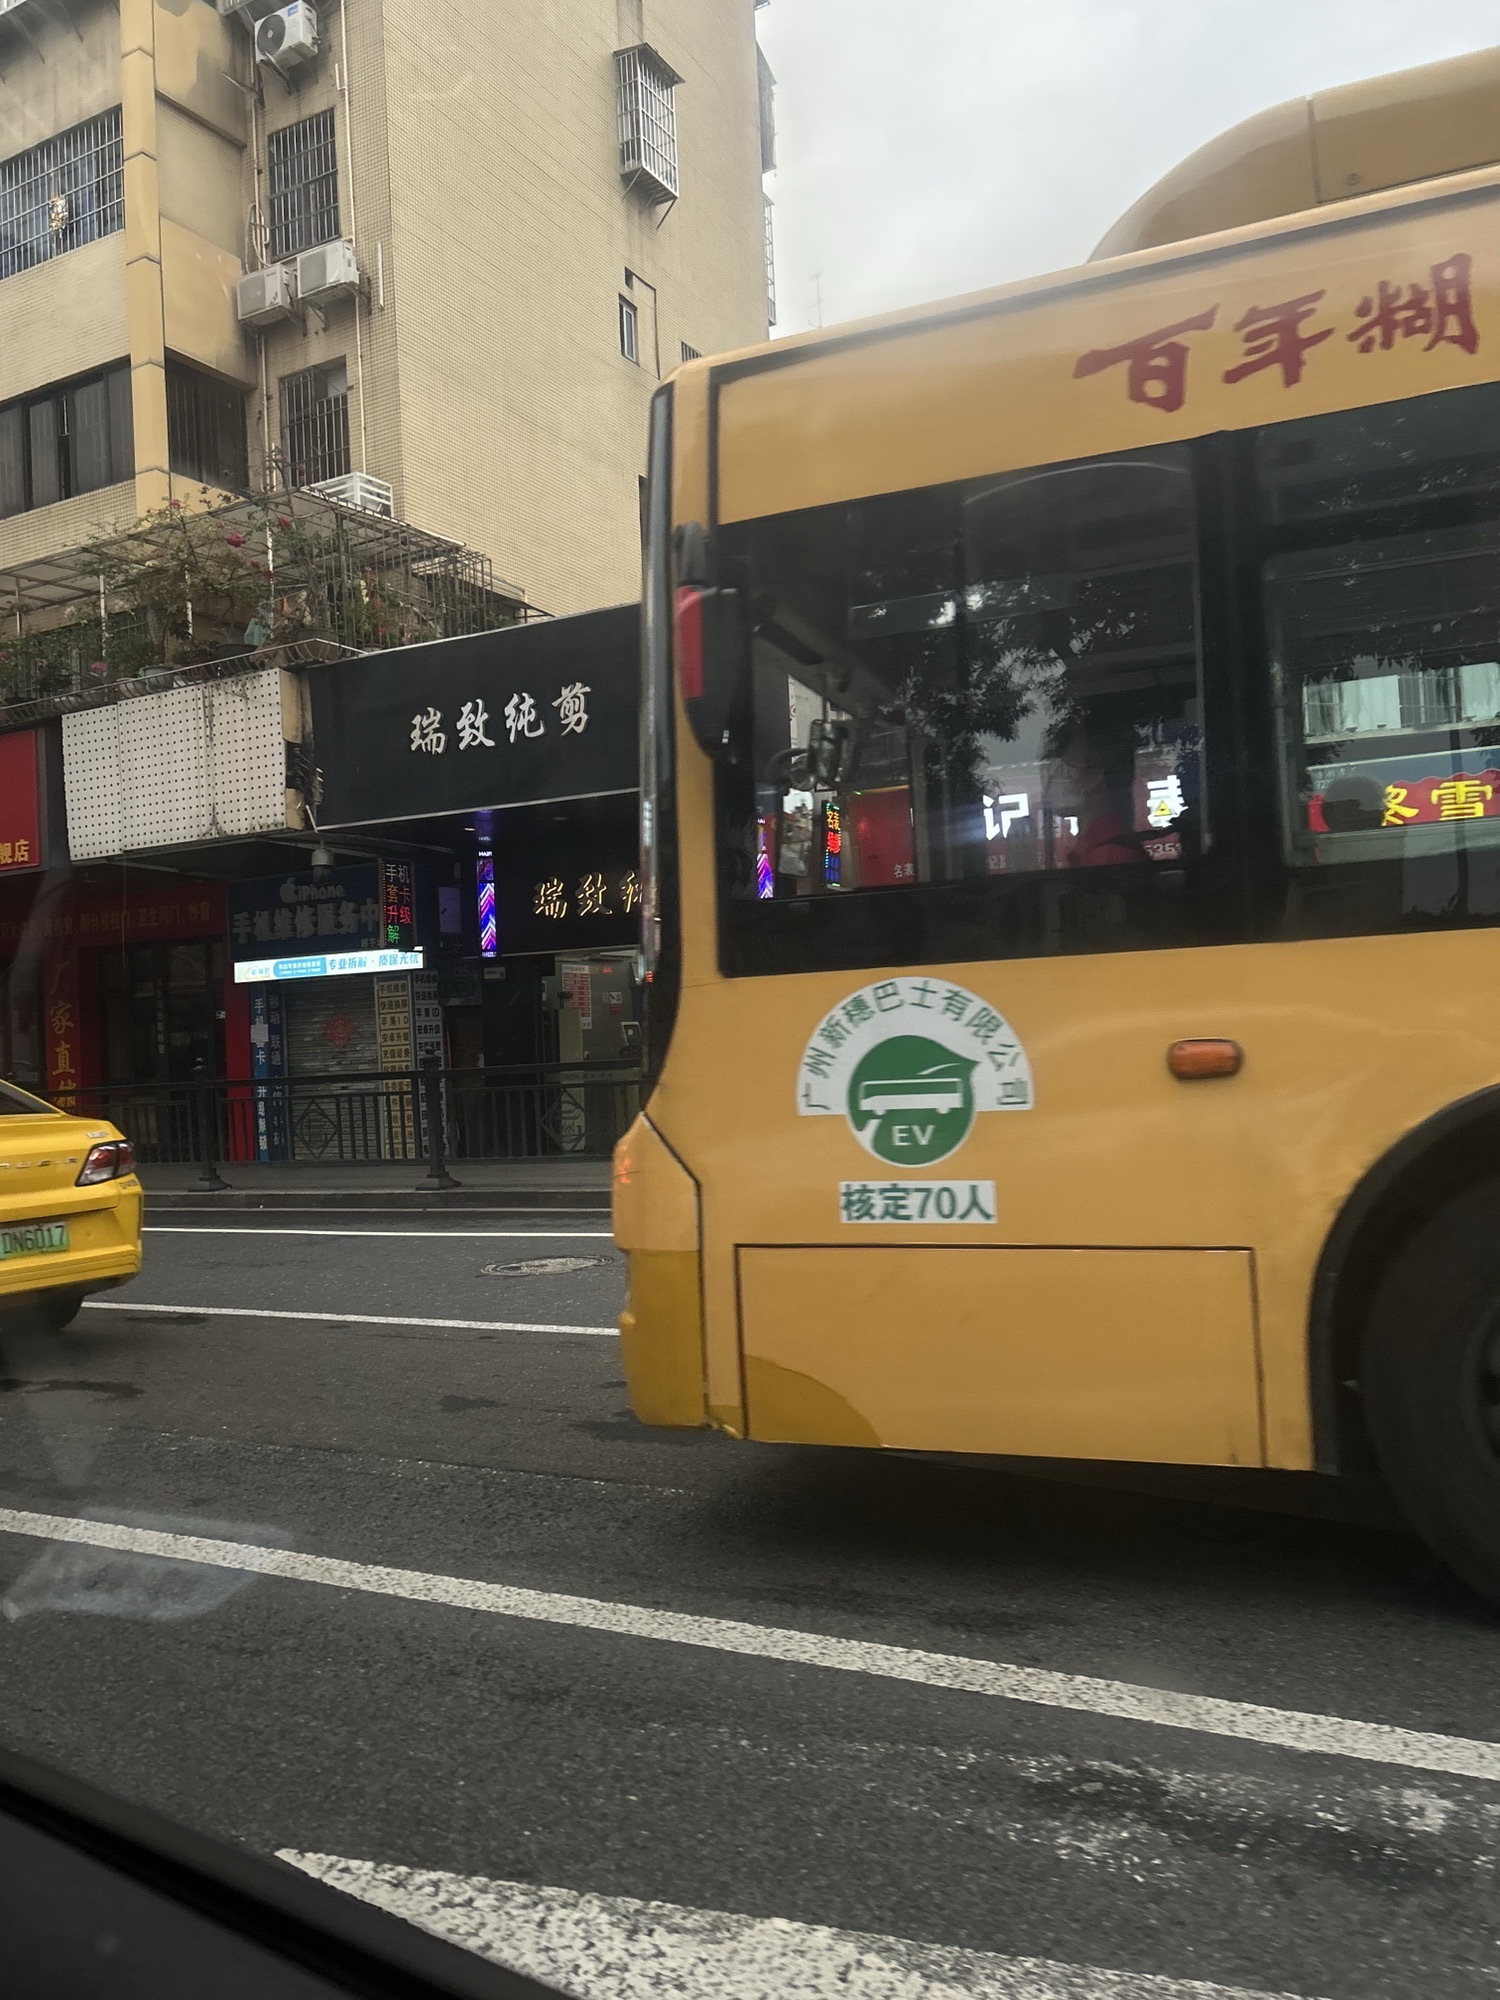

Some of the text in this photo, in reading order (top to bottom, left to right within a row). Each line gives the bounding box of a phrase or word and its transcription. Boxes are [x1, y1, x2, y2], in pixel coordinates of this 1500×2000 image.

[1073, 253, 1480, 413] 百年糊
[410, 682, 592, 755] 瑞致纯剪
[983, 793, 1030, 841] 记
[386, 864, 410, 883] 手机
[386, 884, 410, 904] 套卡
[386, 905, 412, 924] 升级
[892, 1124, 935, 1146] EV
[842, 1183, 994, 1221] 核定70人
